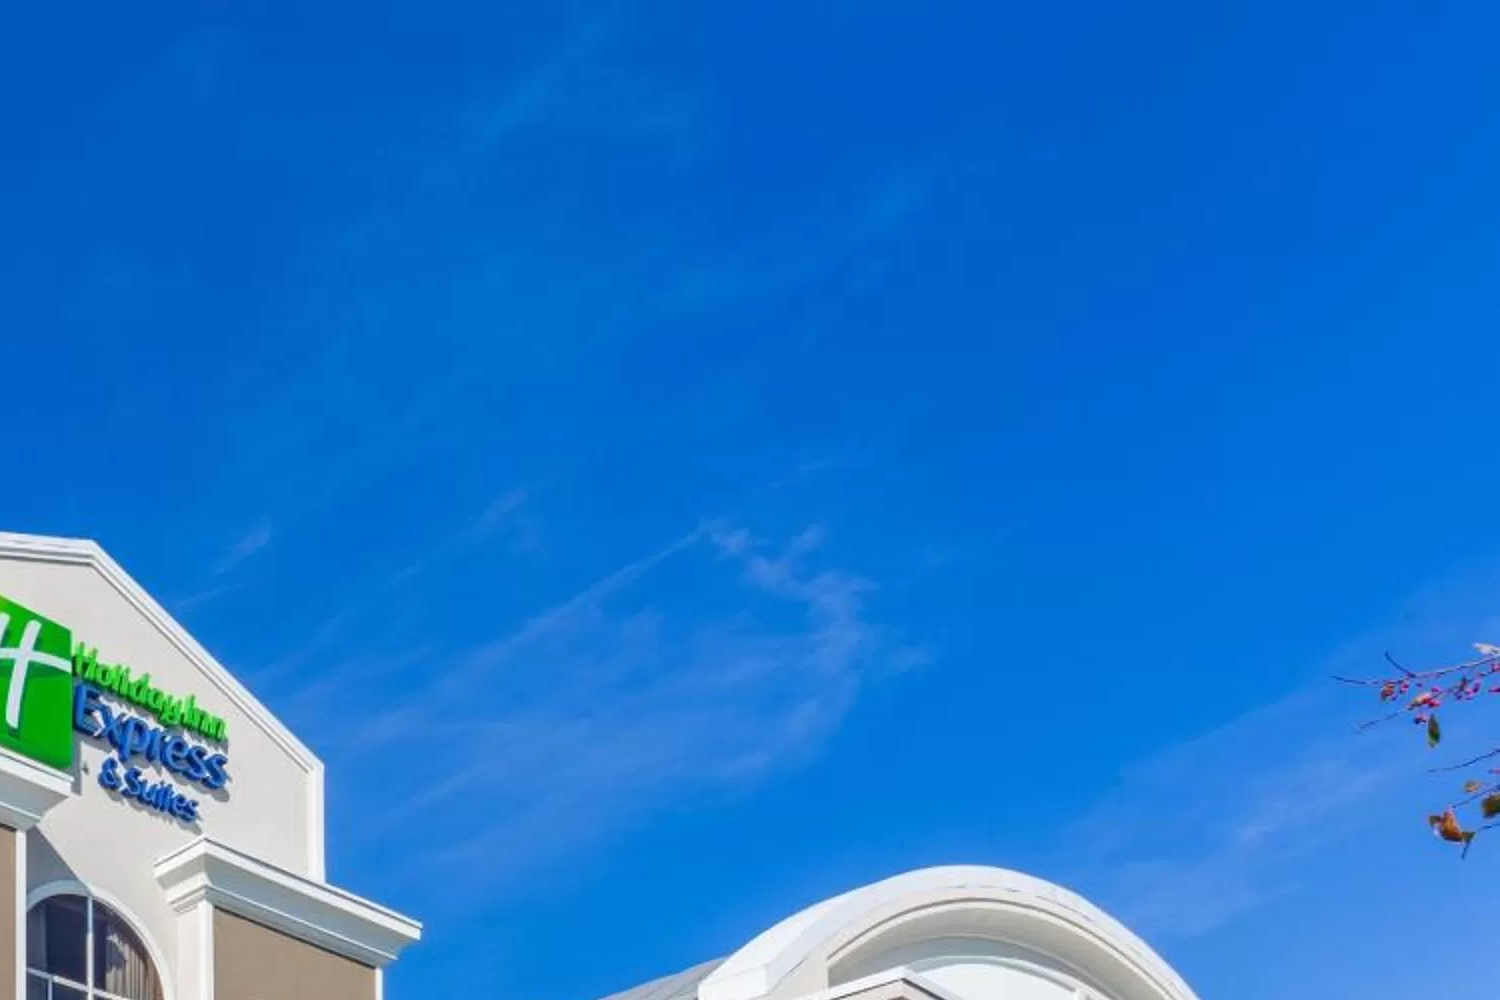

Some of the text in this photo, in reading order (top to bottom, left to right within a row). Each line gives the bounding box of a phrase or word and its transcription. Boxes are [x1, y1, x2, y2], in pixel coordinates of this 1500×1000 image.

[73, 640, 229, 742] Holiday Inn
[74, 683, 229, 790] Express
[98, 756, 199, 822] & Suites
